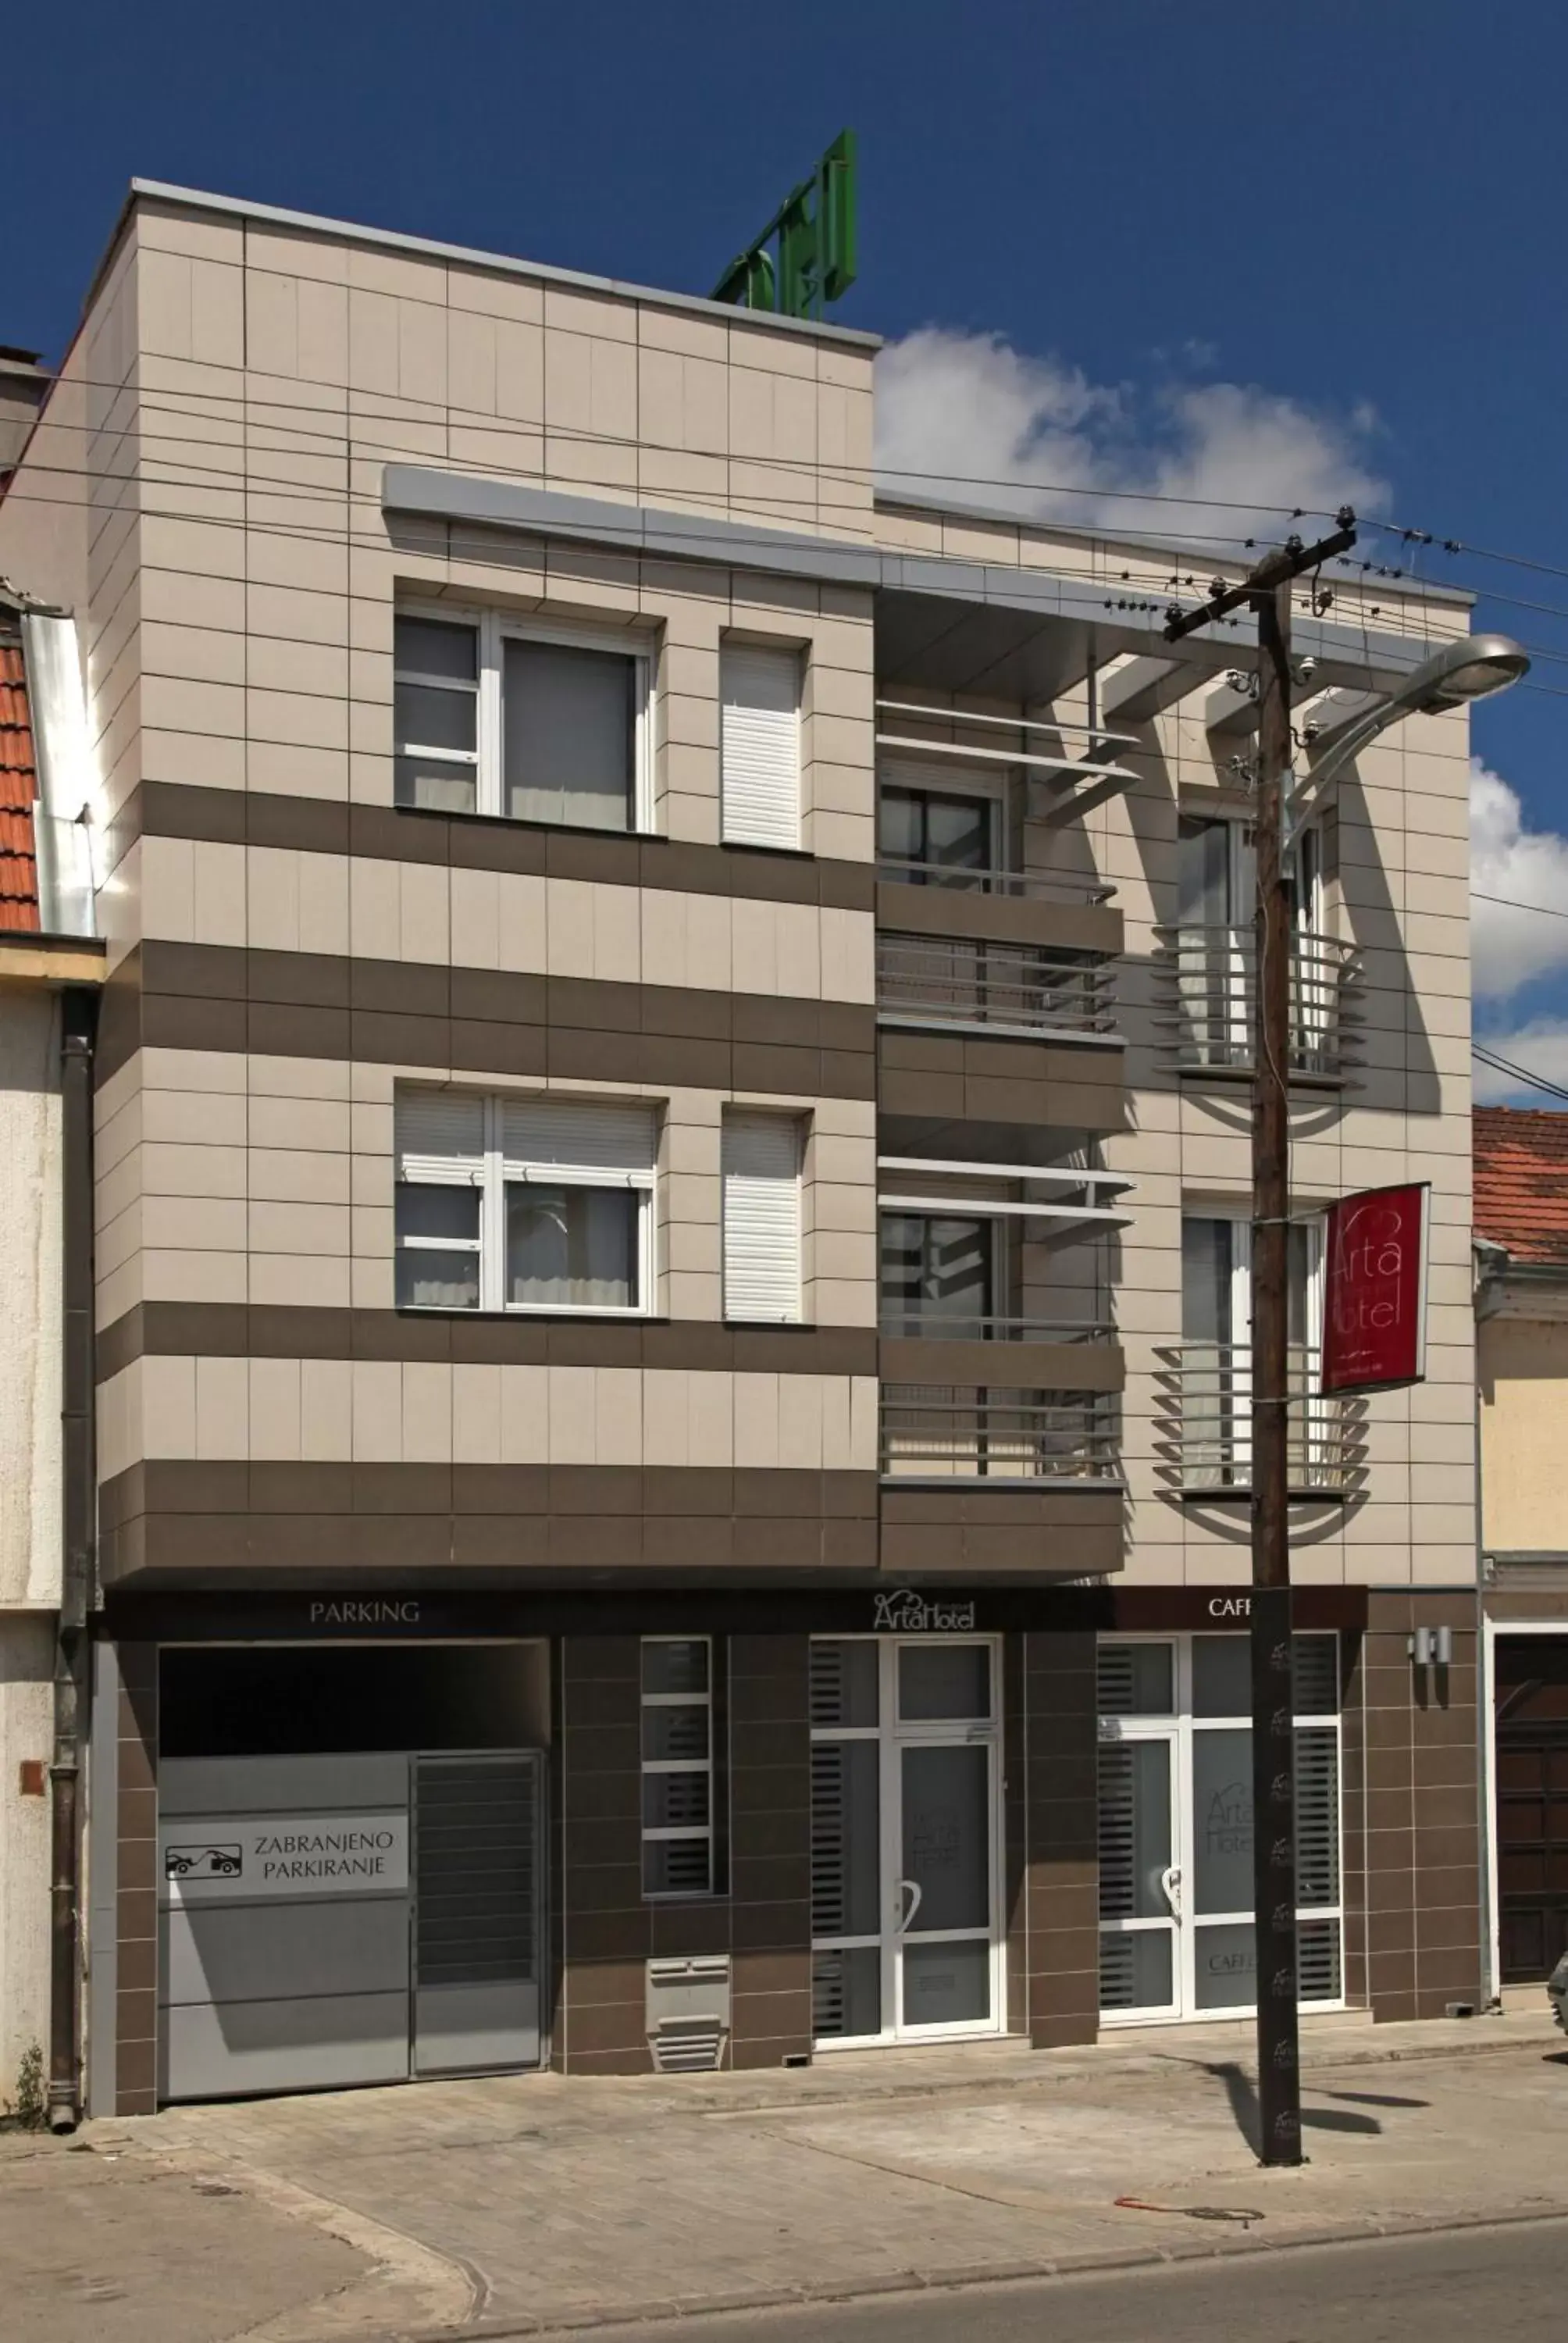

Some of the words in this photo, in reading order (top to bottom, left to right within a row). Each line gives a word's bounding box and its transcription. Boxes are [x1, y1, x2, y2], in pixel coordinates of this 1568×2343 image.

[310, 1602, 419, 1622] PARKING
[255, 1831, 394, 1855] ZABRANJENO
[264, 1856, 386, 1880] PARKIRANJE
